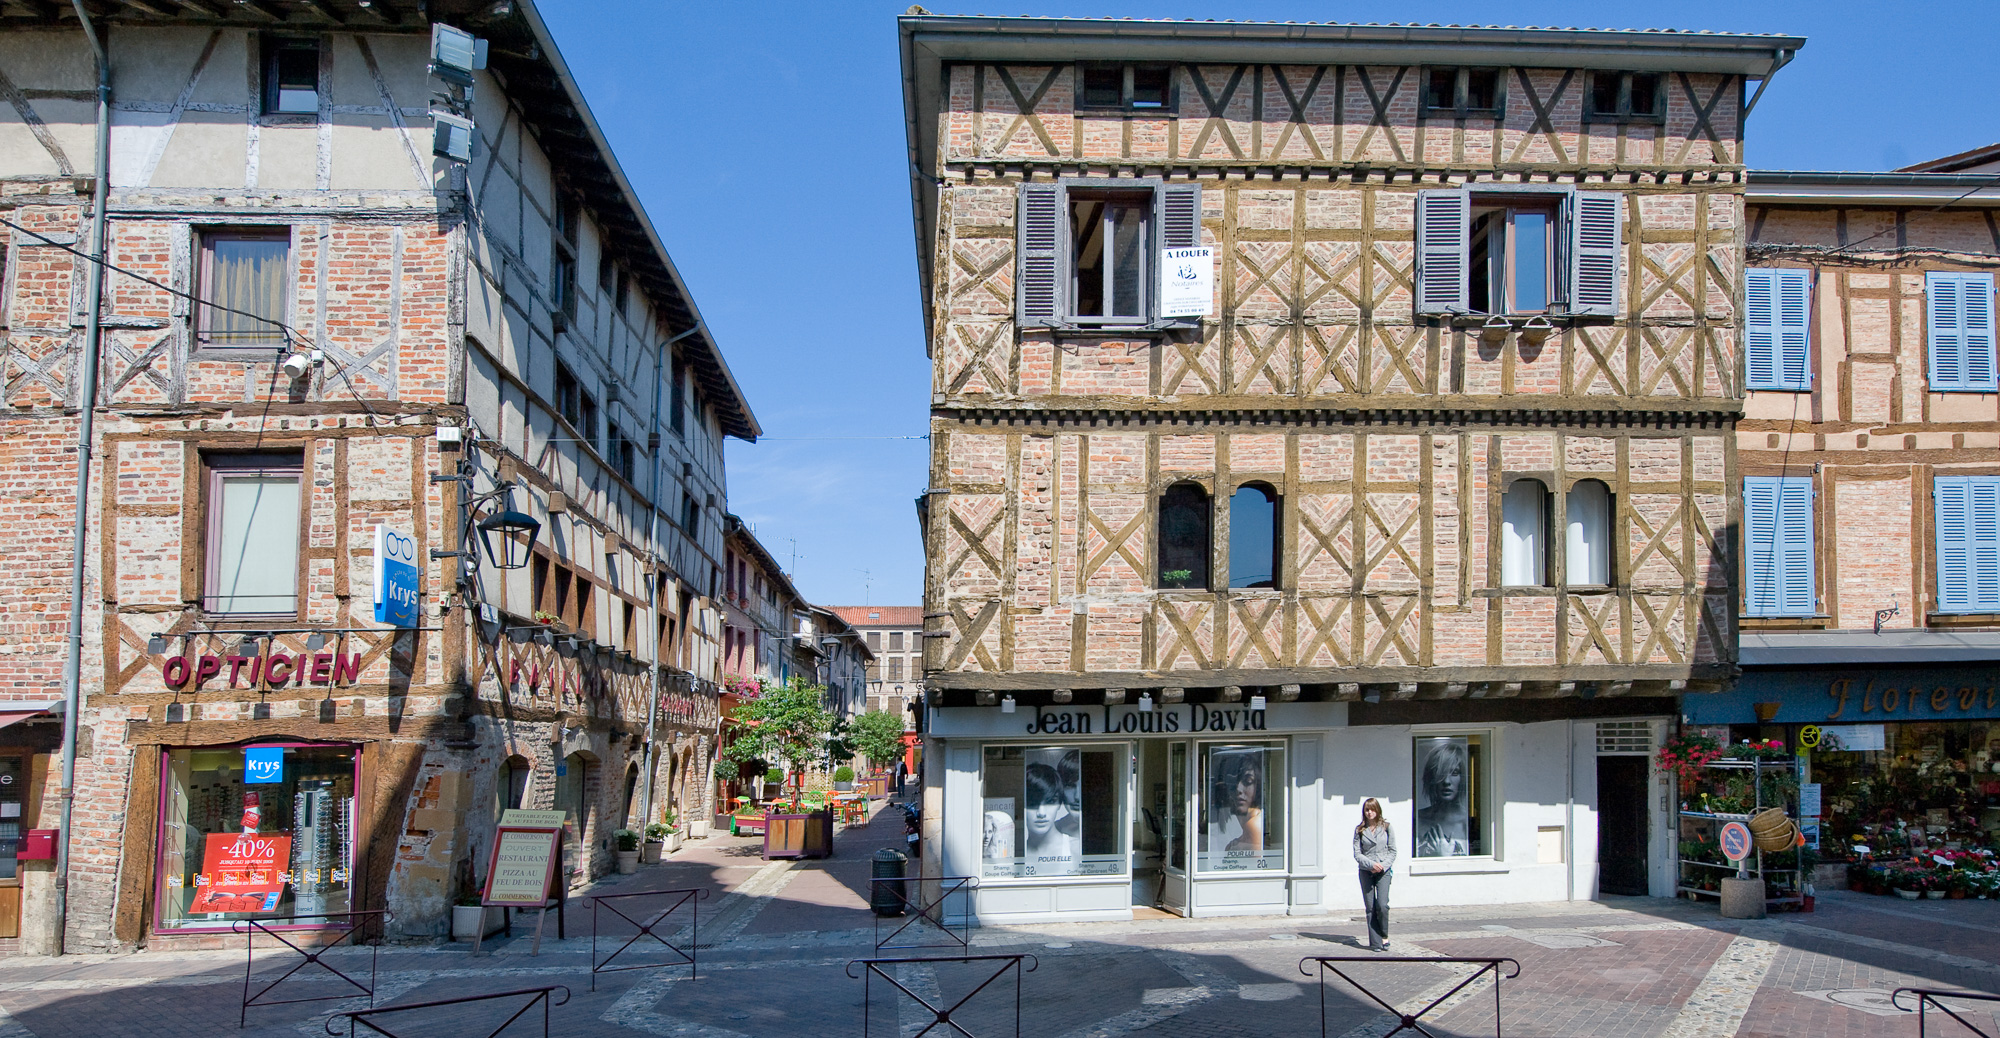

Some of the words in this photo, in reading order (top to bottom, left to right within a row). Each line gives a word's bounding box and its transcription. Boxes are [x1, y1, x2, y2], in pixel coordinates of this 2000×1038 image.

[1176, 249, 1209, 258] LOUER
[389, 580, 418, 608] Krys
[163, 652, 361, 686] OPTICIEN
[1027, 706, 1092, 735] Jean
[1102, 704, 1179, 734] Louis
[1188, 703, 1267, 732] David
[248, 759, 280, 773] Krys
[222, 840, 275, 858] -40%
